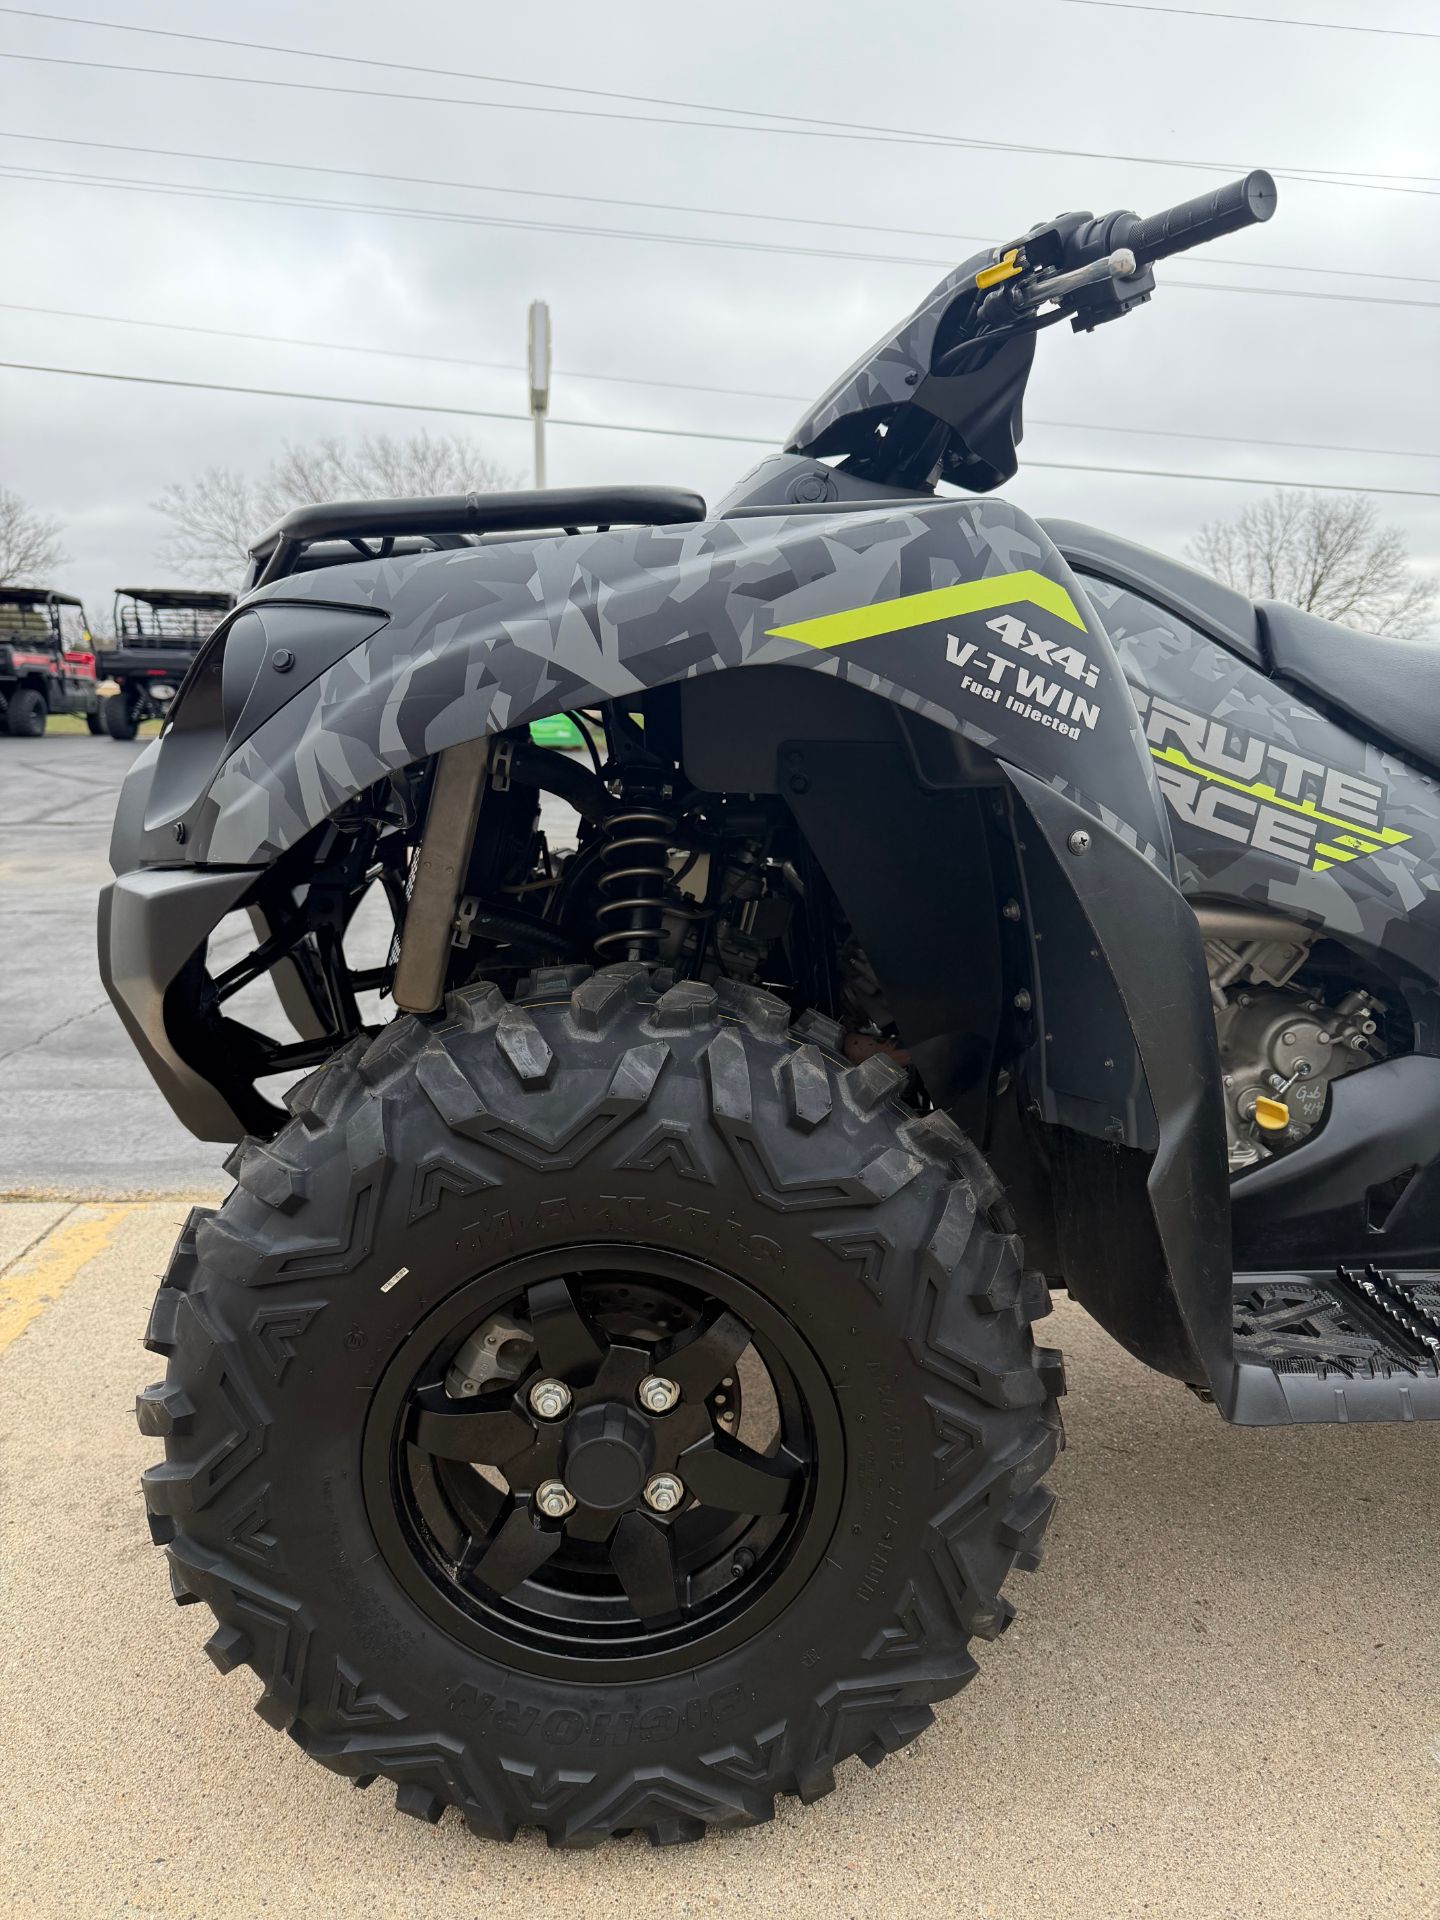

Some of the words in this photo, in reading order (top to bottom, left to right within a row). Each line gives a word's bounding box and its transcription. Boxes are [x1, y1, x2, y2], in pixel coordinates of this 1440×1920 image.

[945, 633, 1101, 730] V-TWIN
[960, 675, 1001, 703] Fuel
[1005, 695, 1081, 741] Injected
[1153, 762, 1319, 866] RCE
